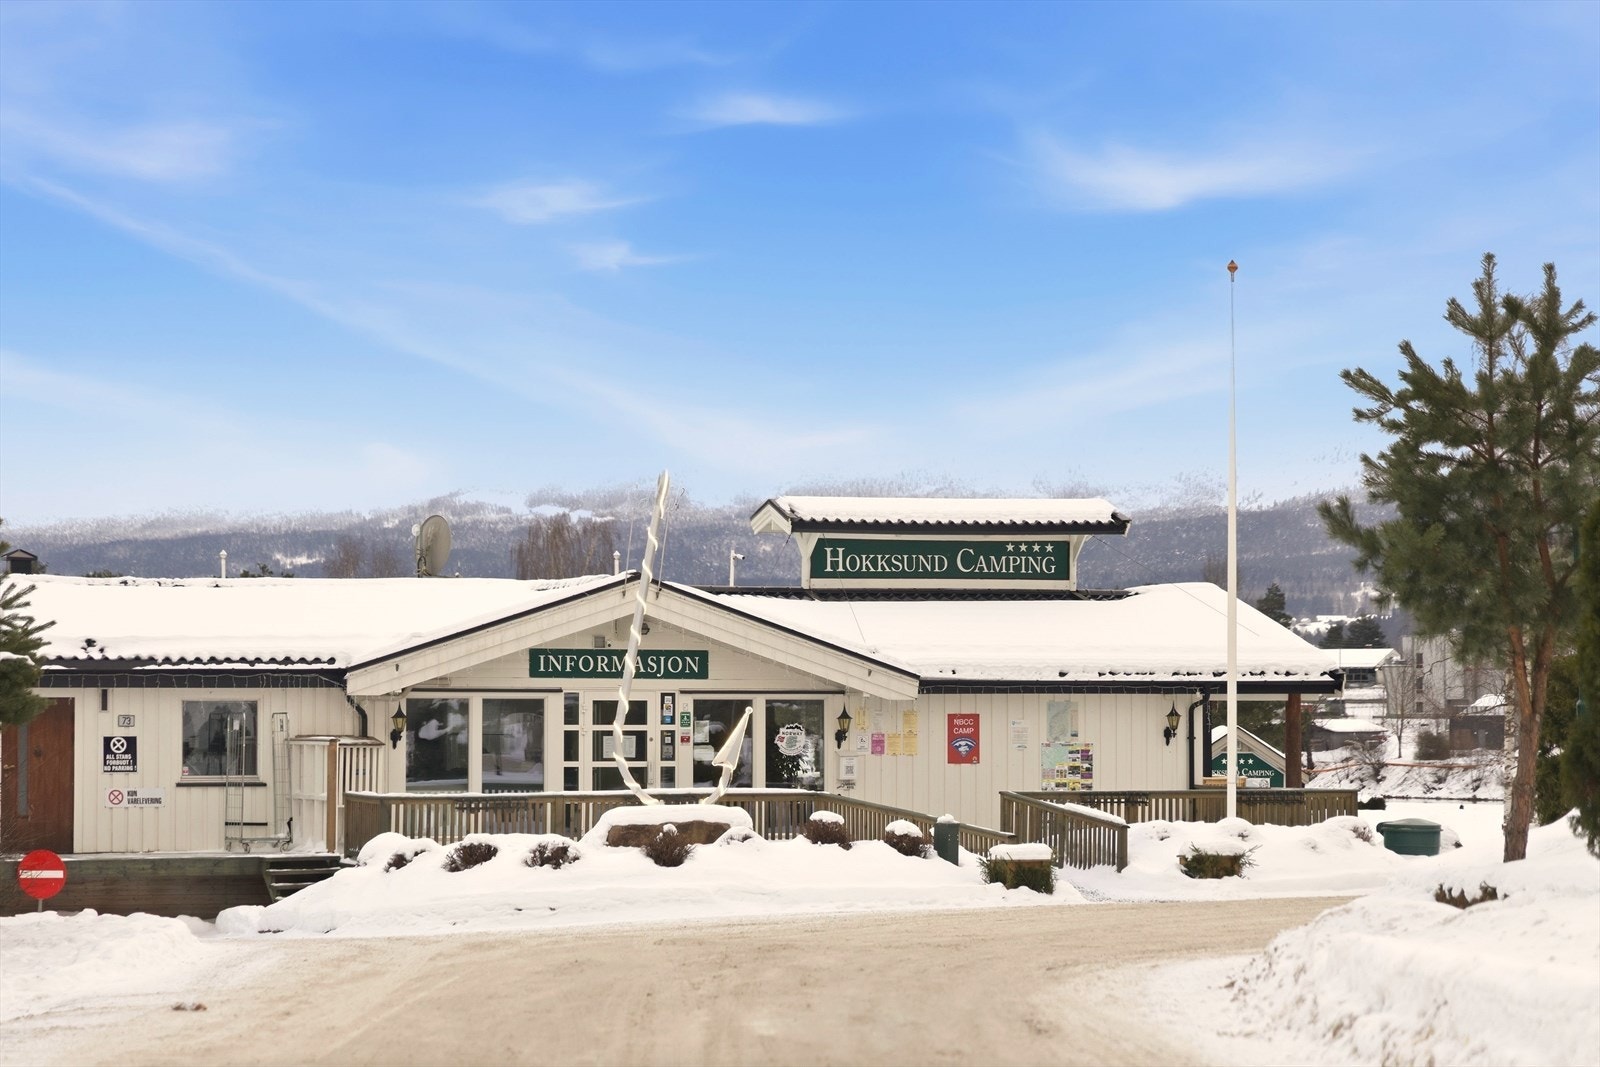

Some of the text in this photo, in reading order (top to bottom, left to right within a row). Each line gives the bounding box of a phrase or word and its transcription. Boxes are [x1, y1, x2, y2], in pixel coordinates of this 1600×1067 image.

[824, 547, 1056, 574] HOKKSUND CAMPING
[538, 654, 699, 677] INFORMASJON
[122, 717, 131, 725] 73
[1242, 768, 1274, 776] CAMPING
